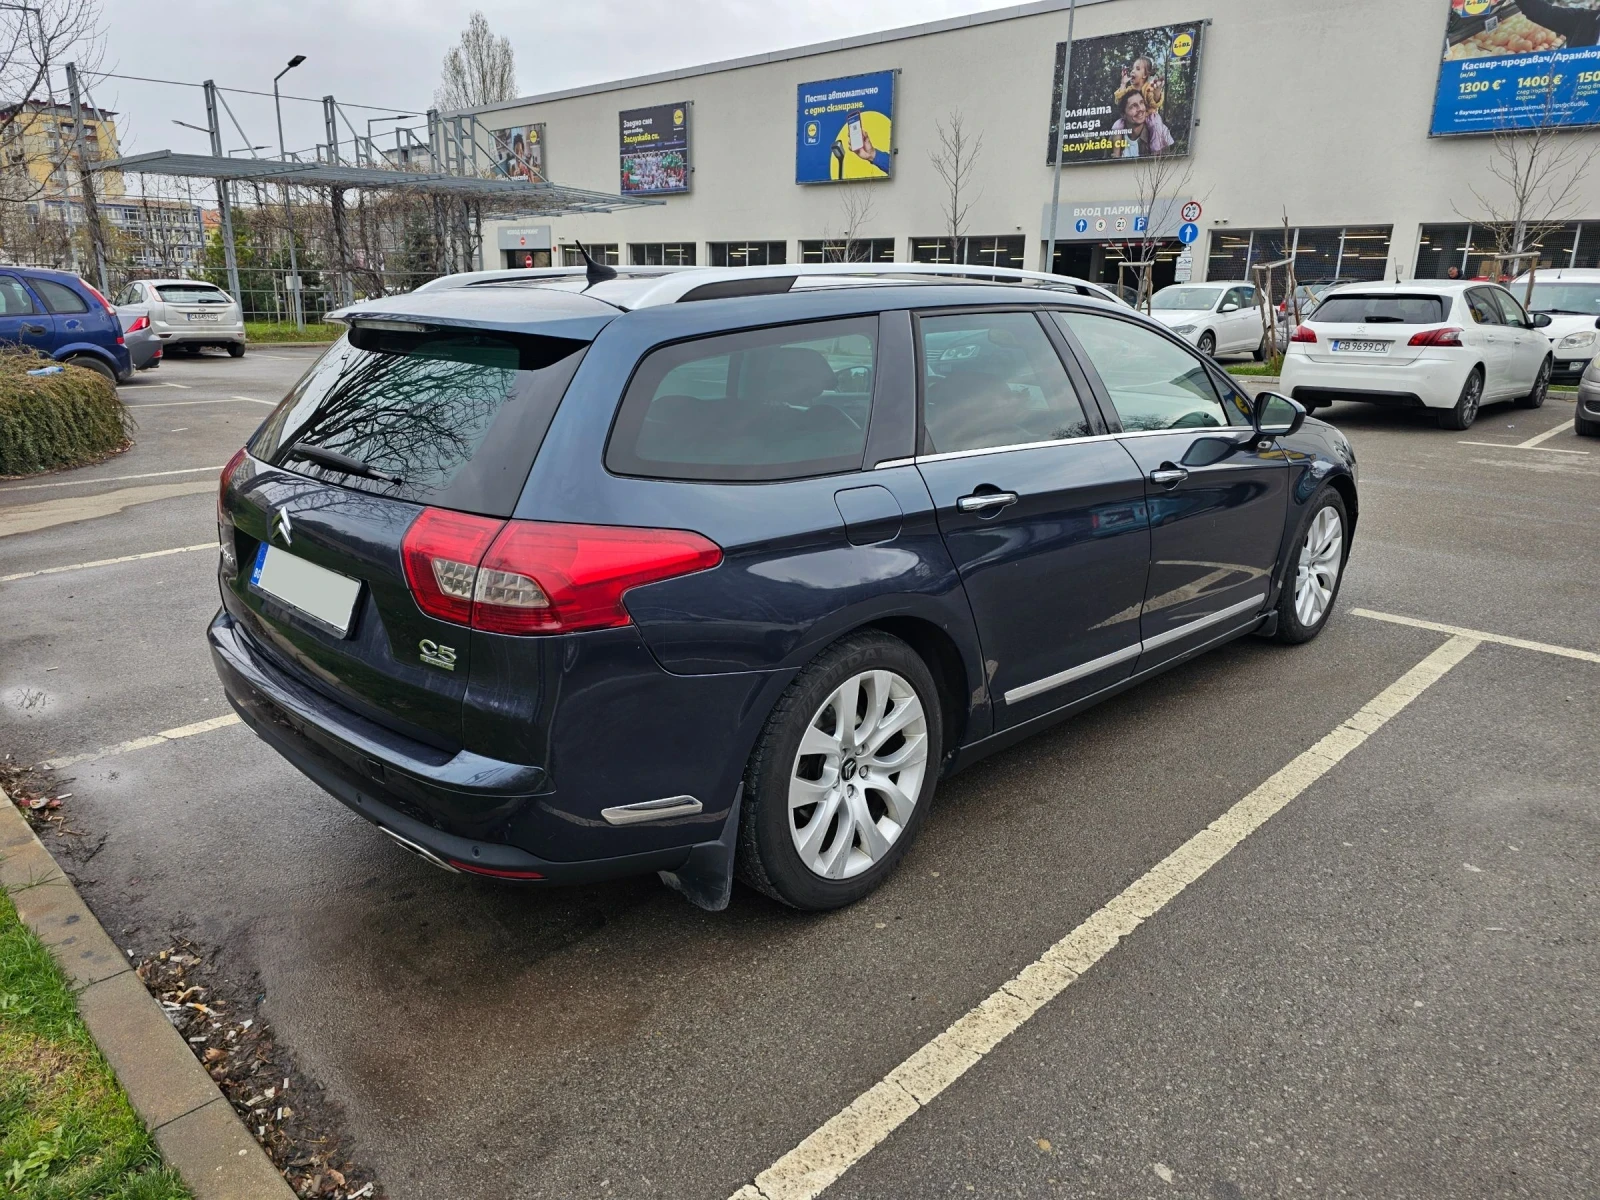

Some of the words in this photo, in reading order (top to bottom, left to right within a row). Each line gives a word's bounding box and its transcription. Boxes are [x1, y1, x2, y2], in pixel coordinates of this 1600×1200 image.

[1459, 81, 1489, 93] 1300
[1517, 75, 1550, 88] 1400
[1553, 73, 1563, 85] €
[805, 95, 827, 103] Пести
[828, 86, 879, 100] автоматично
[810, 106, 825, 116] едно
[827, 101, 865, 112] сканиране.
[1064, 106, 1112, 118] олямата
[1069, 130, 1098, 139] малките
[1099, 128, 1133, 136] моменти
[1061, 138, 1113, 153] аслужава
[1114, 139, 1130, 148] си.
[1073, 207, 1101, 217] ВХОД
[1338, 341, 1350, 350] CB
[1352, 342, 1373, 350] 9699
[1374, 342, 1387, 351] CX
[418, 638, 457, 663] C5
